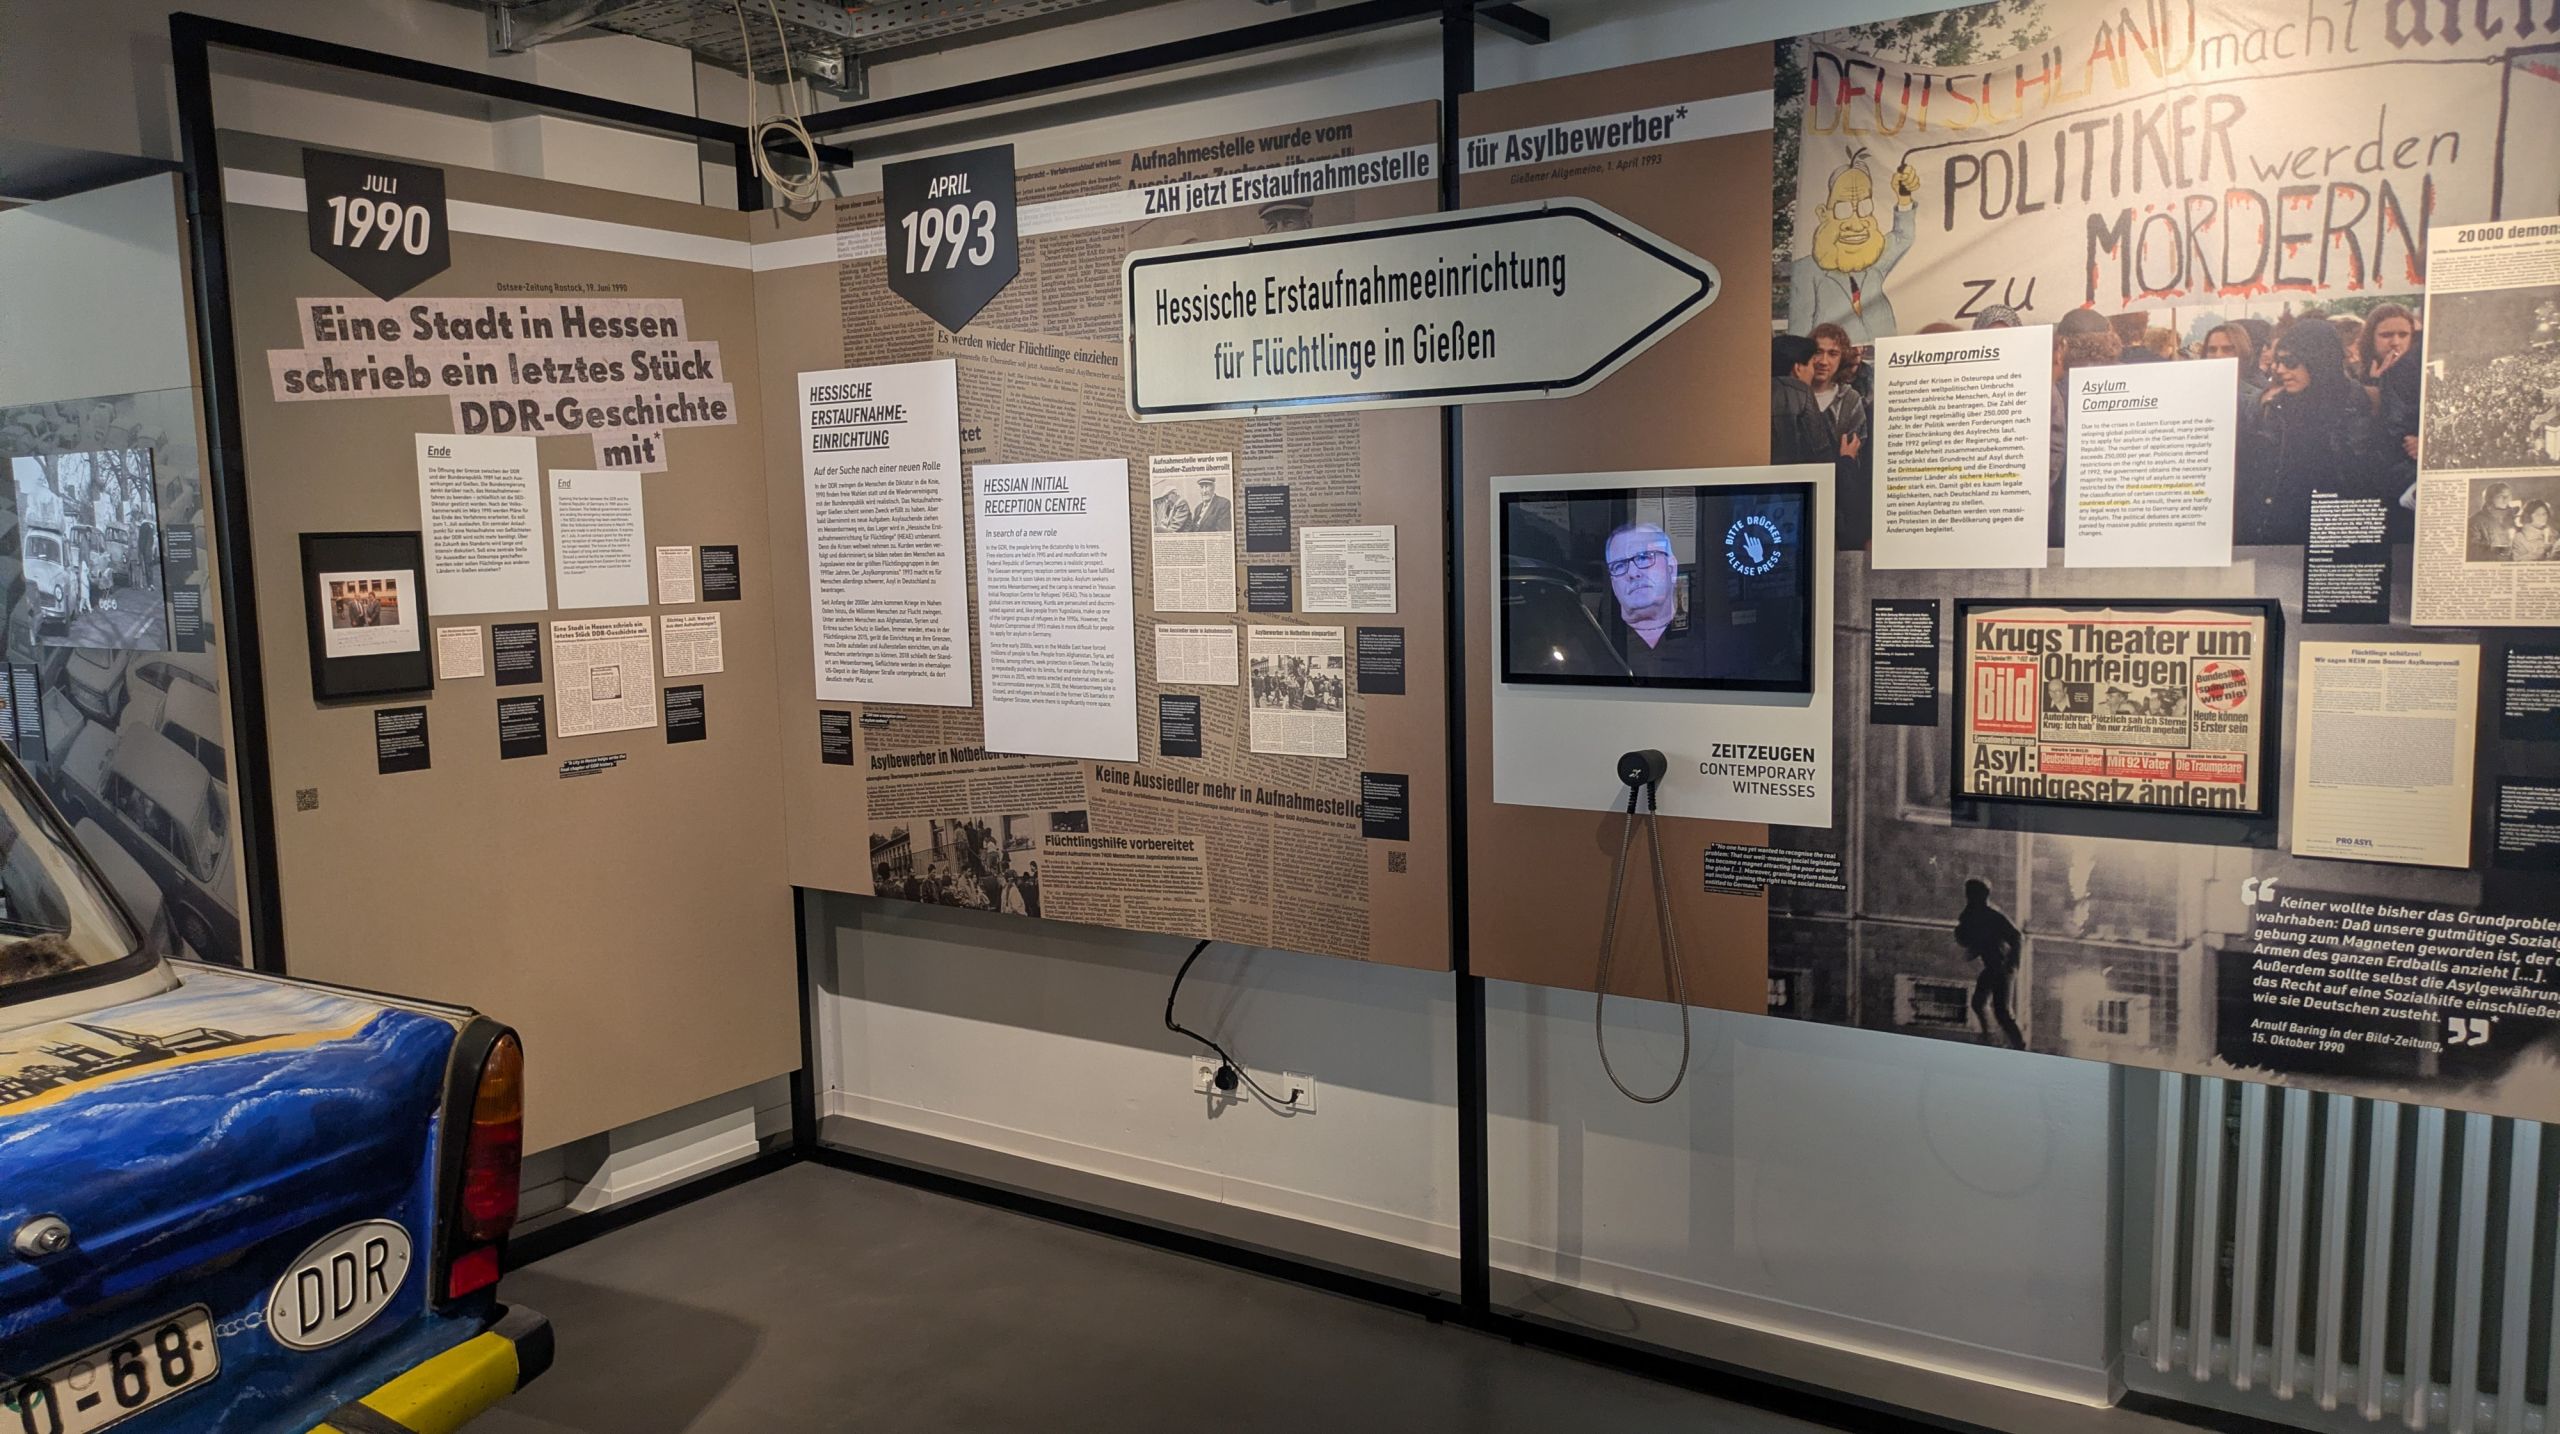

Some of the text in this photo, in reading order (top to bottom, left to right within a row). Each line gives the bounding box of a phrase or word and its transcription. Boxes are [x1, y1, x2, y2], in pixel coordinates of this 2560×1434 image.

[1808, 0, 2195, 137] DEUTSCHLAND
[1131, 136, 1254, 172] Aufnahmestelle
[1258, 128, 1310, 154] wurde
[1315, 123, 1352, 142] vom
[1467, 138, 1499, 169] für
[1607, 161, 1614, 170] 1.
[1616, 156, 1639, 171] April
[1642, 153, 1662, 166] 1993
[1944, 93, 2459, 232] POLITIKER werden
[363, 173, 398, 195] JULI
[927, 172, 971, 200] APRIL
[1144, 186, 1180, 215] ZAH
[1185, 179, 1227, 212] jetzt
[1233, 150, 1430, 202] Erstaufnahmestelle
[327, 195, 431, 256] 1990
[901, 198, 997, 275] 1993
[2458, 227, 2504, 243] 20 000
[2085, 173, 2436, 311] MÖRDERN
[497, 282, 553, 293] Ostsee-Zeitung
[554, 283, 585, 293] Rostock,
[597, 283, 611, 292] Juni
[613, 283, 628, 292] 1990
[1155, 250, 1567, 326] Hessische Erstaufnahmeeinrichtung
[1955, 276, 2035, 320] zu
[310, 304, 678, 343] Eine Stadt in Hessen
[937, 330, 949, 344] Es
[951, 334, 983, 349] werden
[986, 337, 1016, 353] wieder
[1019, 341, 1071, 362] Flüchtlinge
[1073, 350, 1119, 366] einziehen
[1213, 319, 1496, 381] für Flüchtlinge in Gießen
[1888, 346, 2000, 367] Asylkompromiss
[283, 349, 714, 394] schrieb ein letztes Stück
[810, 382, 872, 401] HESSISCHE
[2082, 380, 2126, 394] Asylum
[459, 392, 727, 435] DDR-Geschichte
[811, 405, 907, 426] ERSTAUFNAHME-
[2082, 395, 2159, 411] Compromise
[427, 445, 451, 456] Ende
[812, 429, 889, 450] EINRICHTUNG
[814, 461, 941, 476] Auf der Suche nach einer neuen Rolle
[557, 479, 571, 488] End
[984, 476, 1069, 493] HESSIAN INITIAL
[984, 497, 1087, 514] RECEPTION CENTRE
[986, 529, 993, 537] In
[994, 528, 1015, 537] search
[1016, 528, 1022, 537] of
[1043, 528, 1057, 536] role
[1725, 516, 1782, 545] BITTE DRÜCKEN
[1726, 551, 1781, 576] PLEASE PRESS
[1976, 622, 2251, 655] Krugs Theater um
[2044, 653, 2187, 688] Ohrfeigen
[1978, 666, 2034, 723] Bild
[2193, 722, 2248, 734] 5 Erster sein
[2194, 710, 2248, 722] Heute können
[870, 749, 948, 770] Asylbewerber in
[1711, 744, 1815, 763] ZEITZEUGEN
[1973, 743, 2035, 774] Asyl:
[1700, 763, 1816, 781] CONTEMPORARY
[1095, 765, 1130, 786] Keine
[1133, 770, 1199, 796] Aussiedler
[1202, 781, 1237, 800] mehr
[1240, 784, 1252, 802] in
[1256, 787, 1363, 818] Aufnahmestelle
[1733, 780, 1815, 798] WITNESSES
[1974, 770, 2246, 809] Grundgesetz ändern!
[1045, 834, 1195, 852] Flüchtlingshilfe vorbereitet
[2336, 837, 2373, 847] PRO ASYL
[2280, 896, 2454, 922] Keiner wollte bisher das
[2254, 909, 2506, 946] wahrhaben: Daß unsere gutmütige
[2253, 925, 2552, 965] gebung zum Magneten geworden ist, der
[2253, 943, 2509, 978] Armen des ganzen Erdballs anzieht
[2253, 959, 2560, 1004] Außerdem sollte selbst die Asylgewährun
[2253, 975, 2463, 1007] das Recht auf eine Sozialhilfe
[2253, 992, 2440, 1022] wie sie Deutschen zusteht.
[2251, 1019, 2443, 1052] Arnulf Baring in der Bild-Zeitung,
[2253, 1033, 2344, 1053] 15. Oktober 1990
[296, 1237, 390, 1337] DDR
